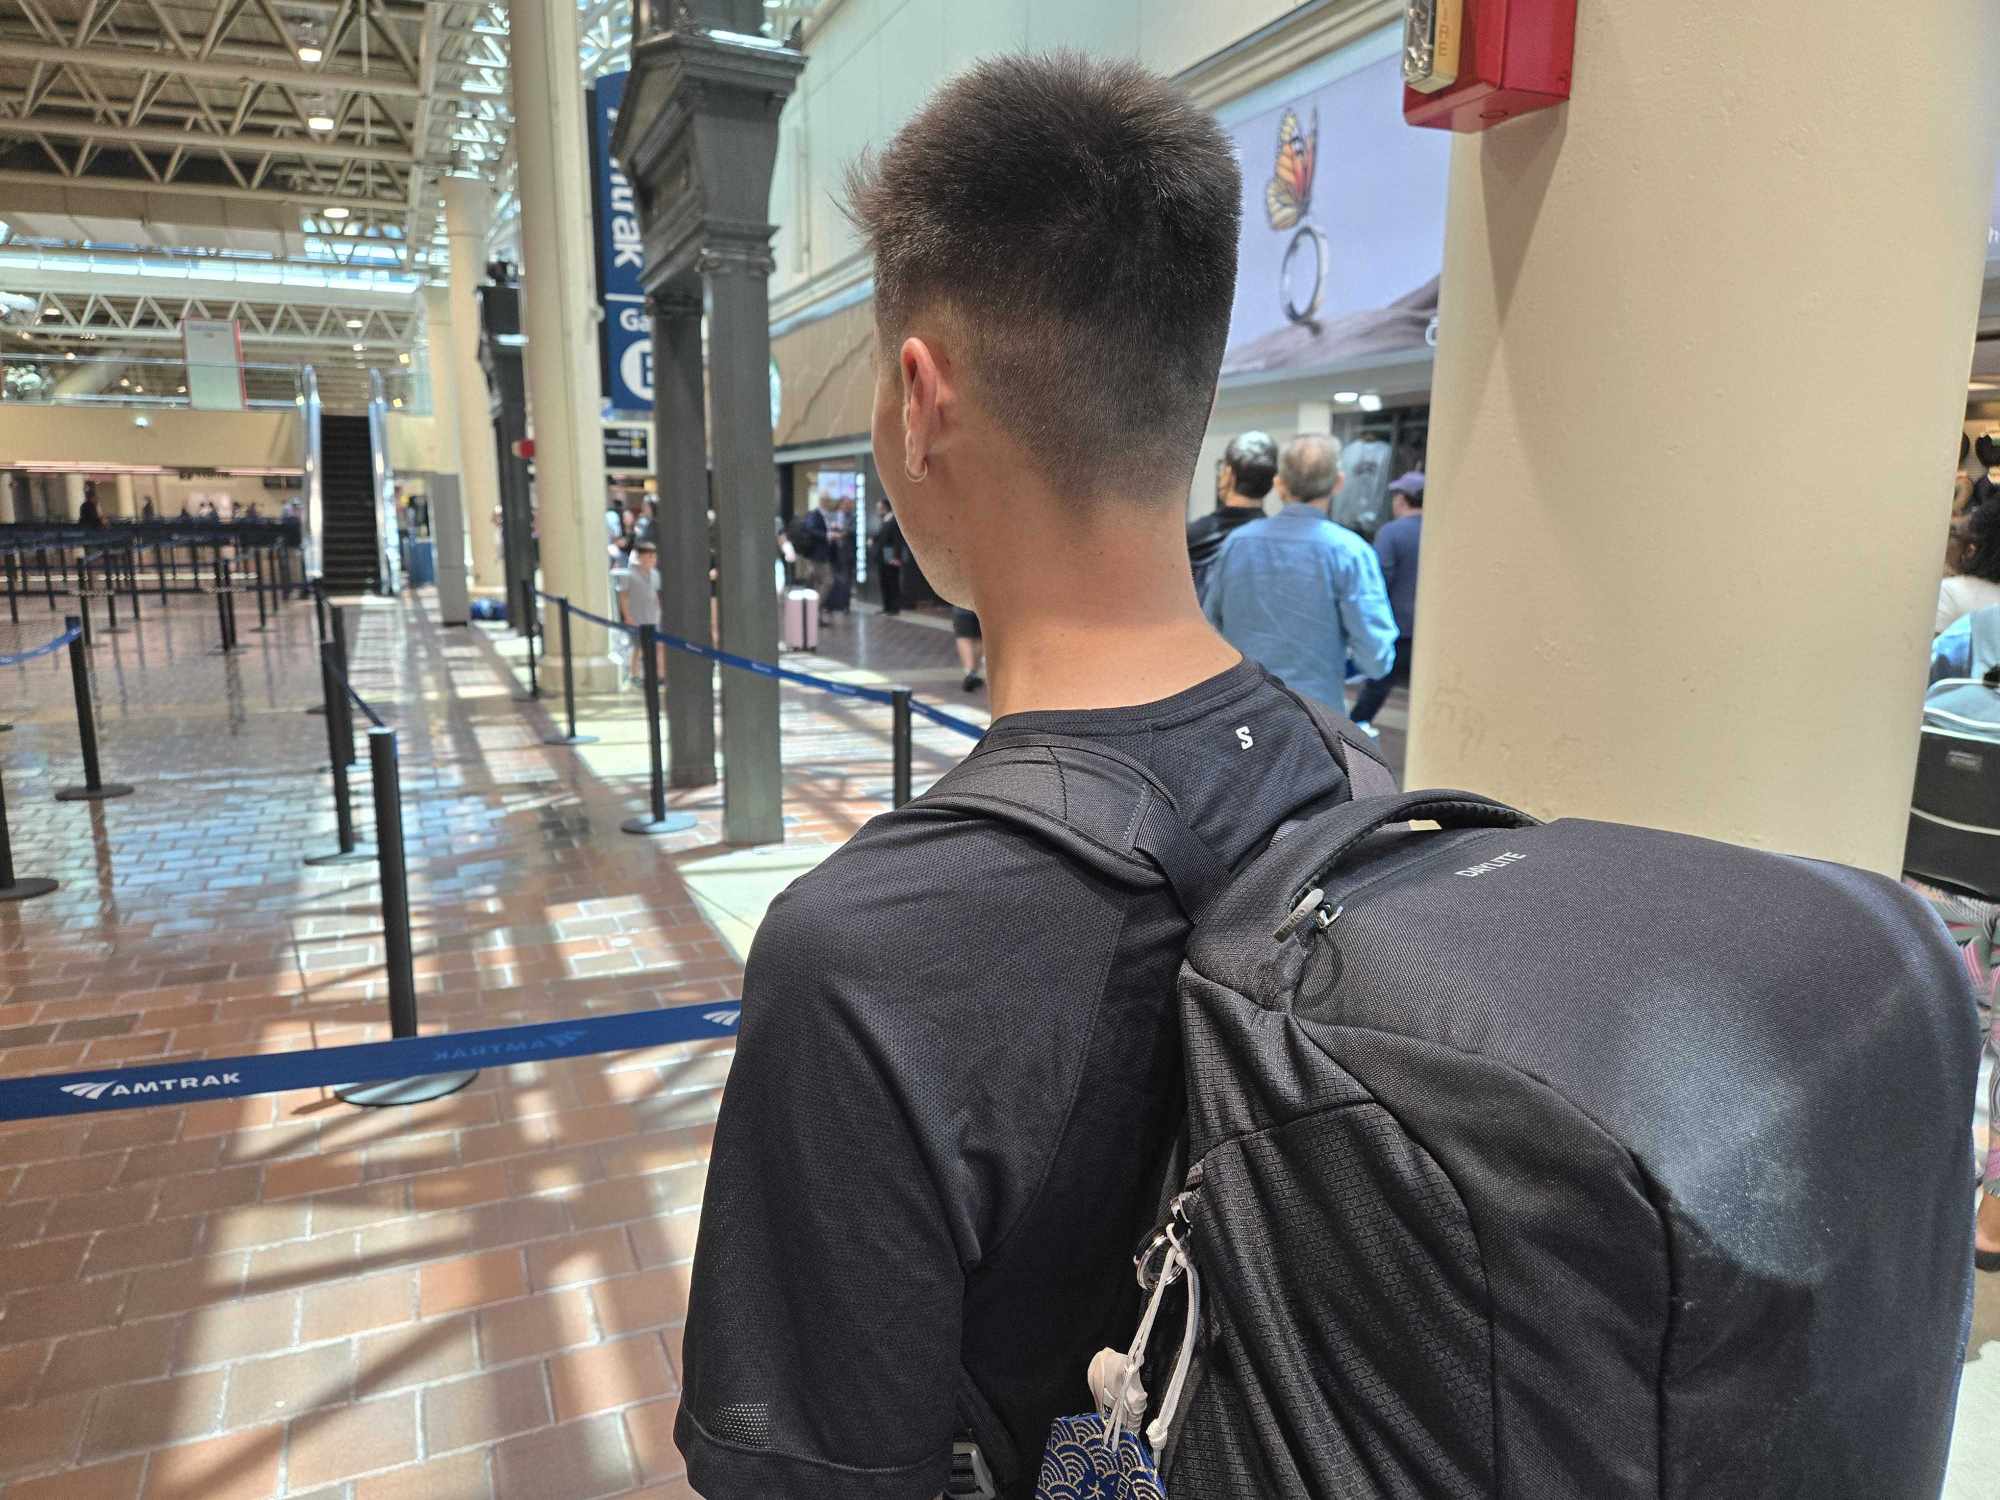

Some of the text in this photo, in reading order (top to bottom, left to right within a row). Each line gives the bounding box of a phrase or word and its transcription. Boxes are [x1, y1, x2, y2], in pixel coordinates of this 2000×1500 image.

[1236, 726, 1253, 749] S
[1453, 851, 1528, 877] DAYLITE
[111, 1072, 241, 1096] AMTRAK
